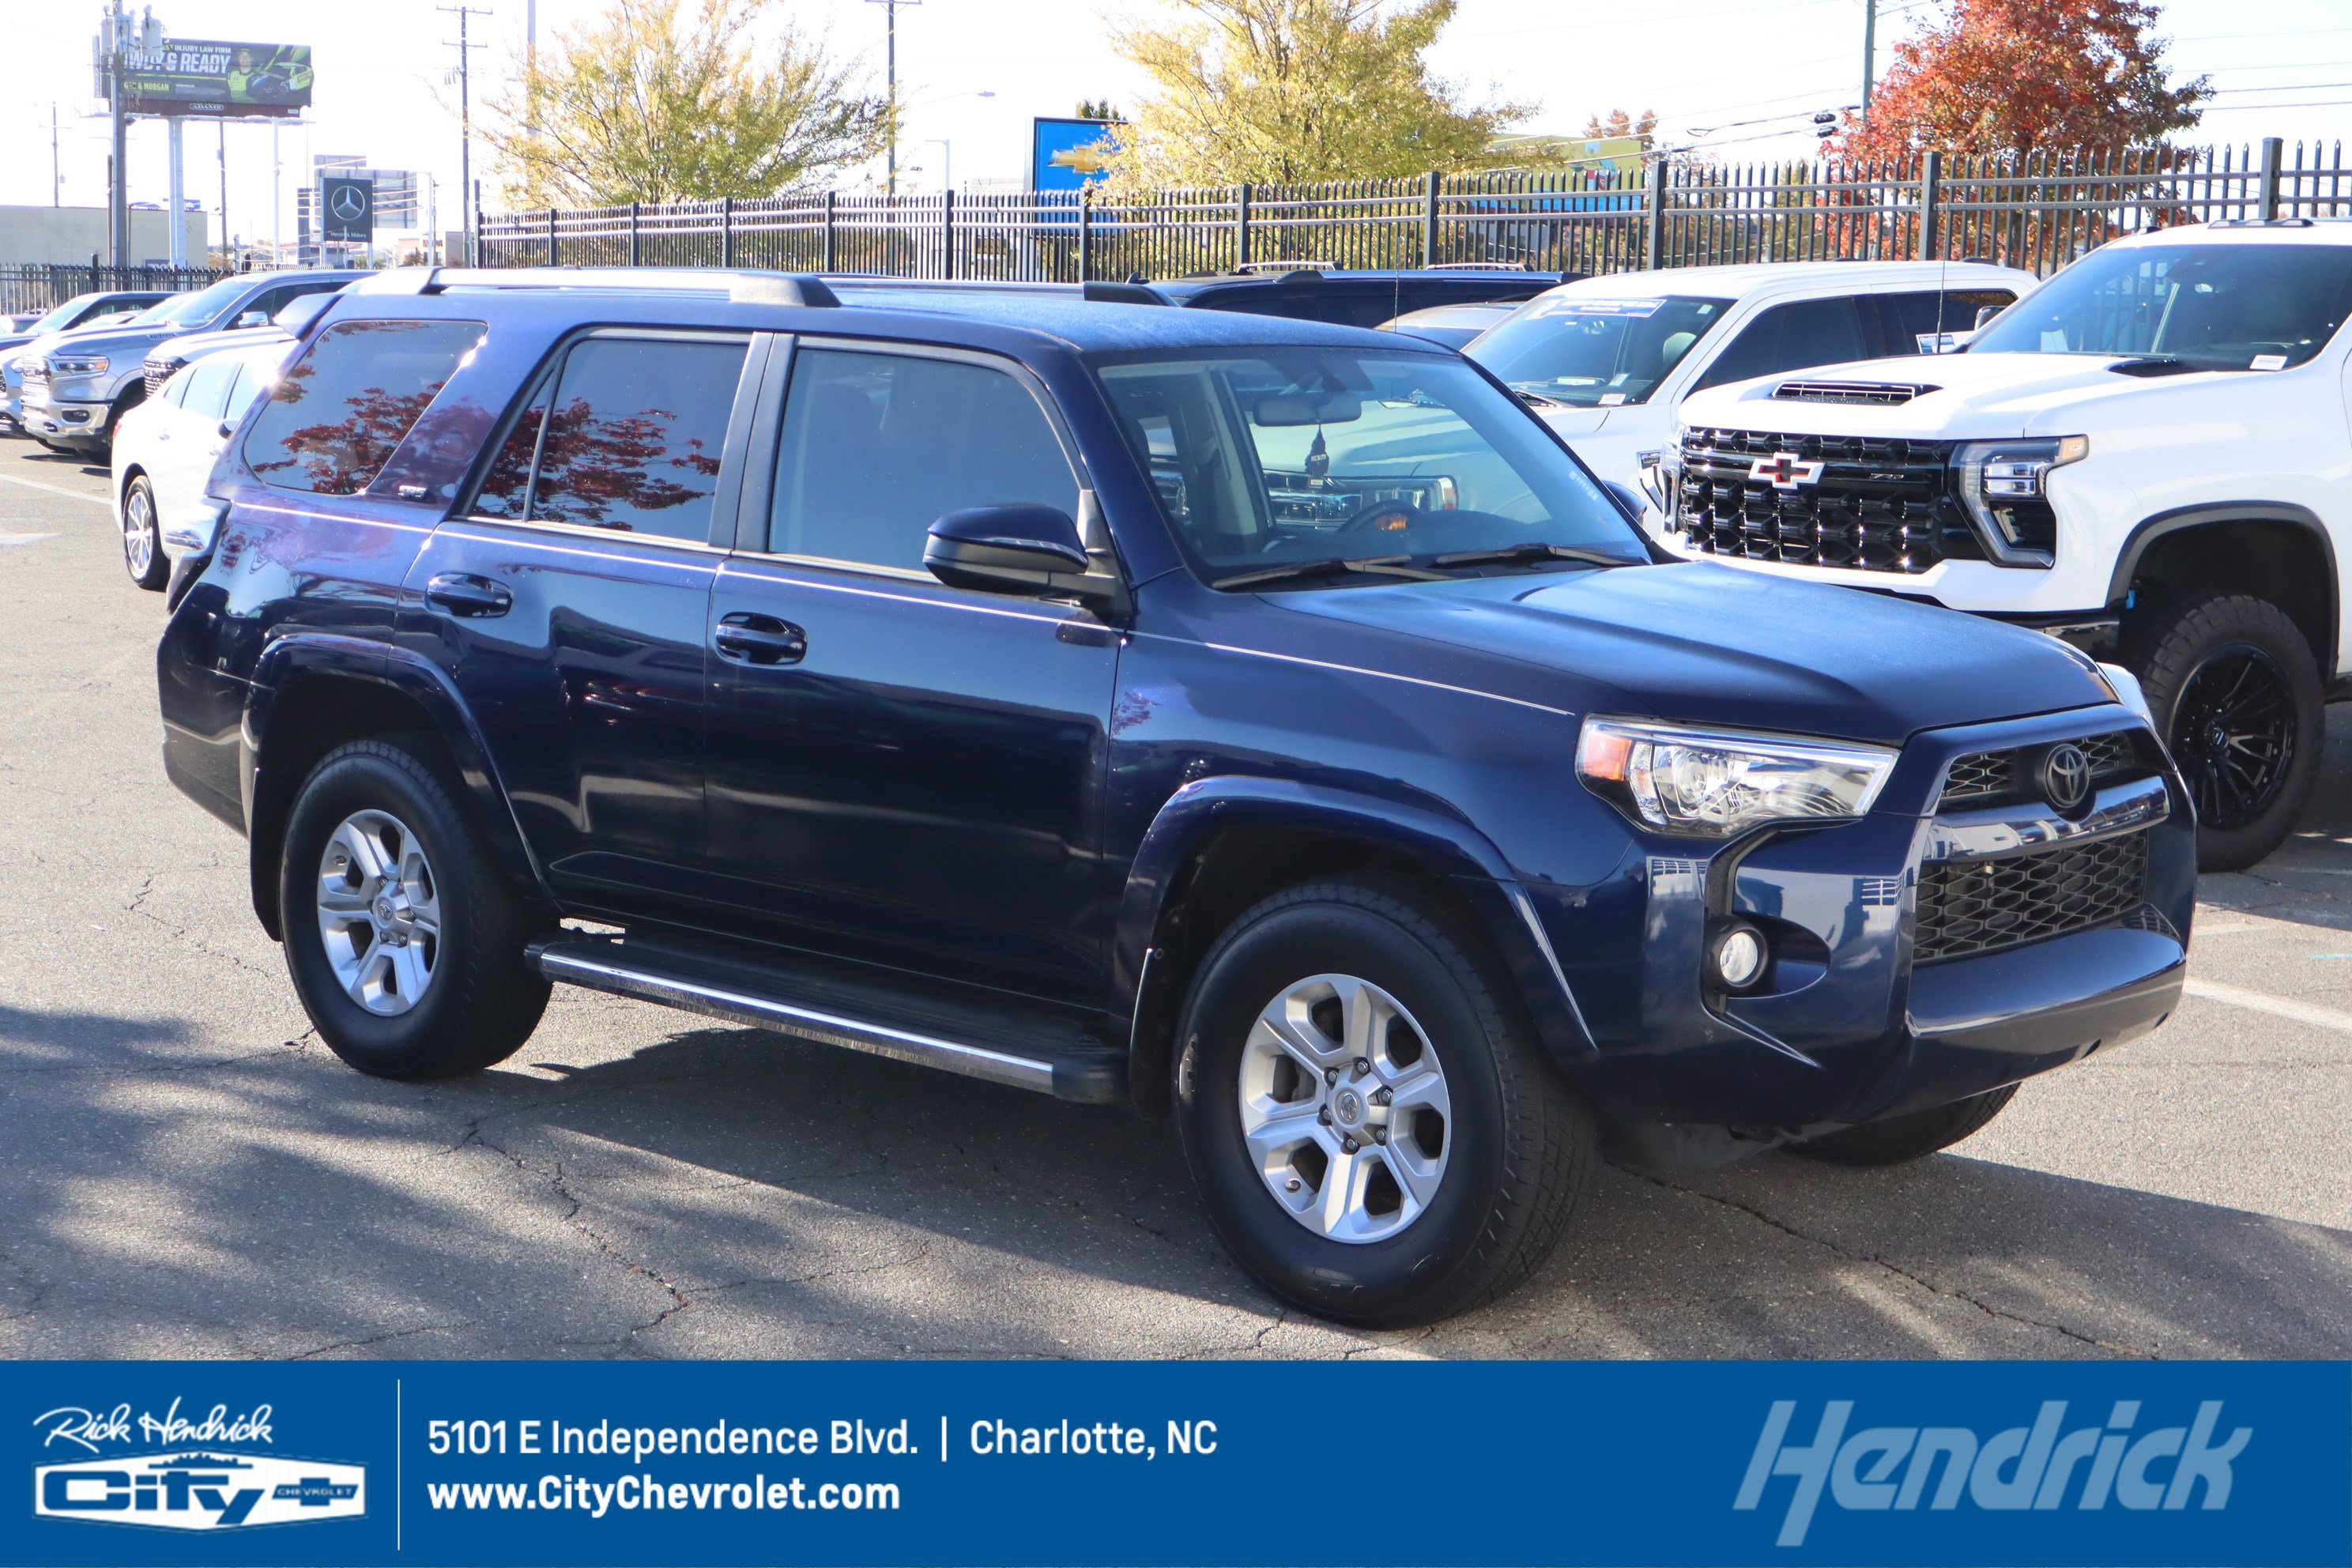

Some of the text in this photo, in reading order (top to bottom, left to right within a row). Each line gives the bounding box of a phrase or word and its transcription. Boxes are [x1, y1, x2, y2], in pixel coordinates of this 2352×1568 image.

[175, 44, 198, 53] INJURY
[180, 52, 231, 74] READY
[144, 82, 169, 91] MORGAN
